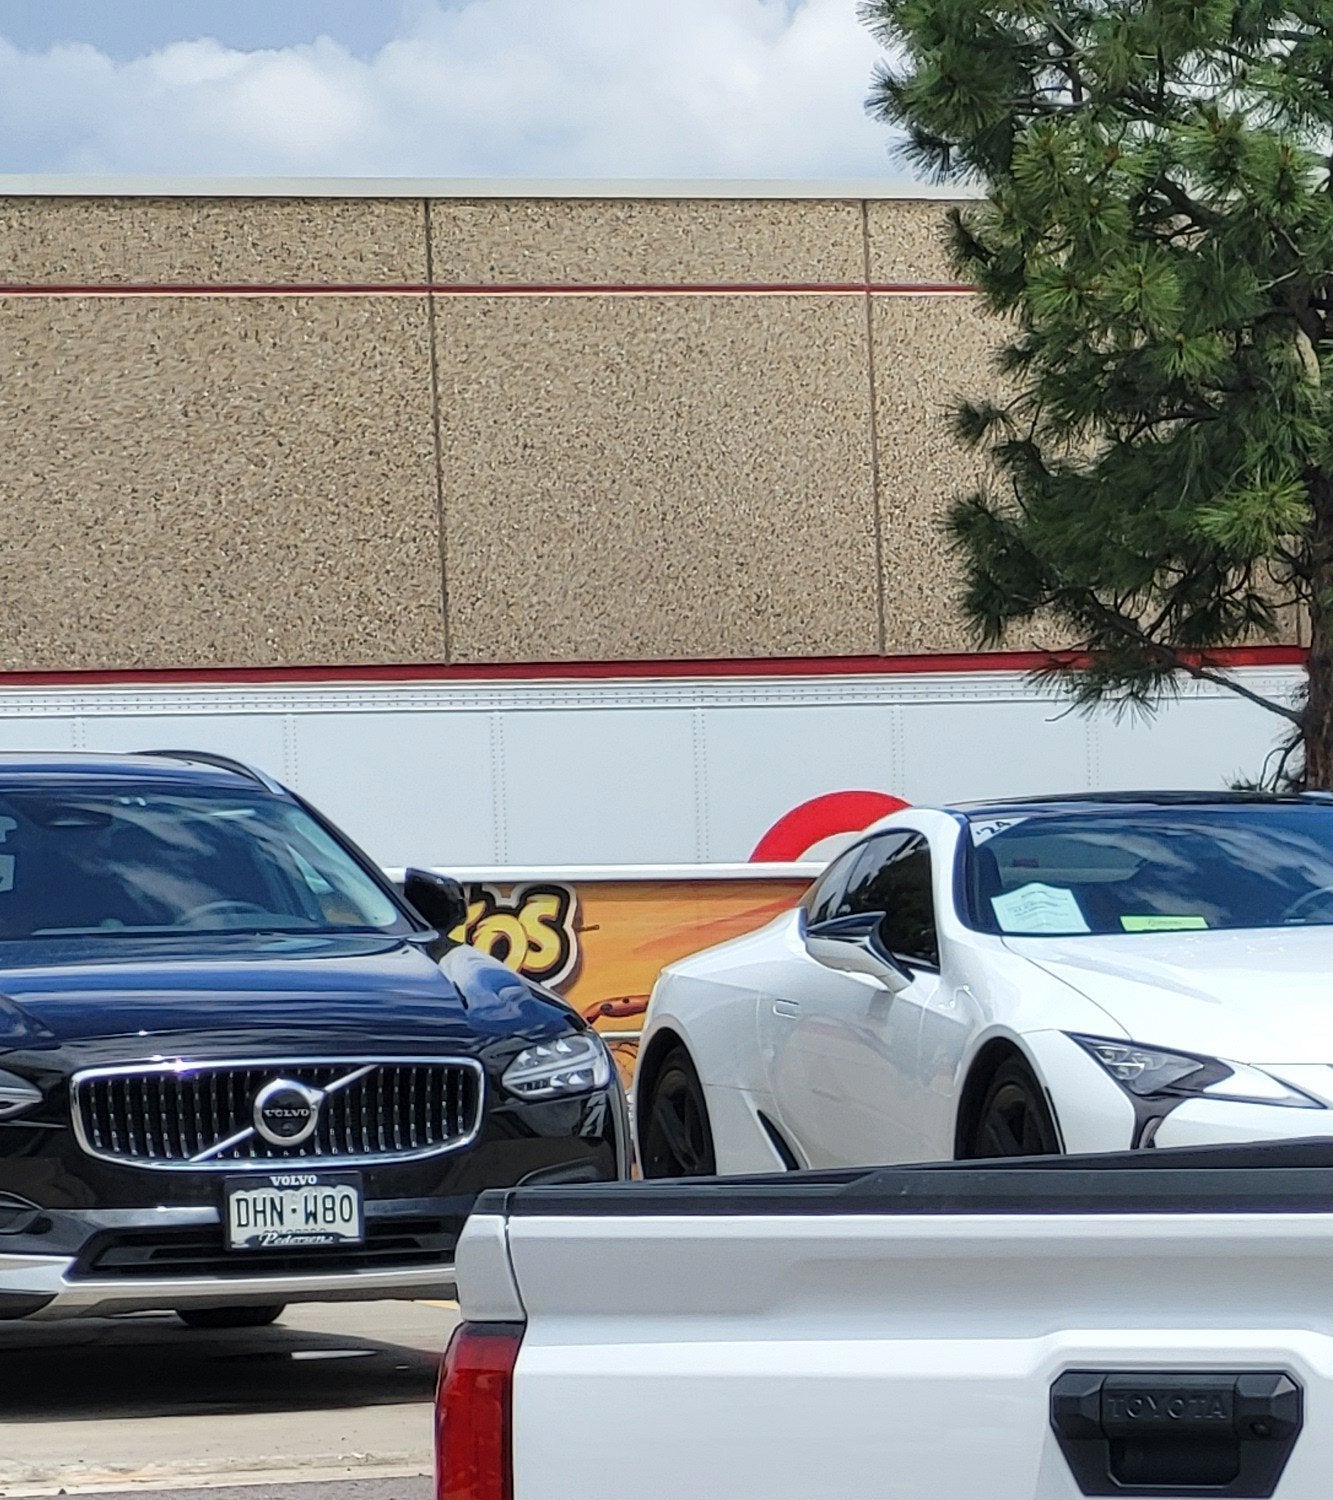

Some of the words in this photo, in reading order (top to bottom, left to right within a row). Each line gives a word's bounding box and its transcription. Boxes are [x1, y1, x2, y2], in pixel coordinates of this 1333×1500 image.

[263, 1108, 310, 1117] VOLVO
[269, 1174, 318, 1186] VOLVO
[1107, 1397, 1227, 1419] TOYOTA
